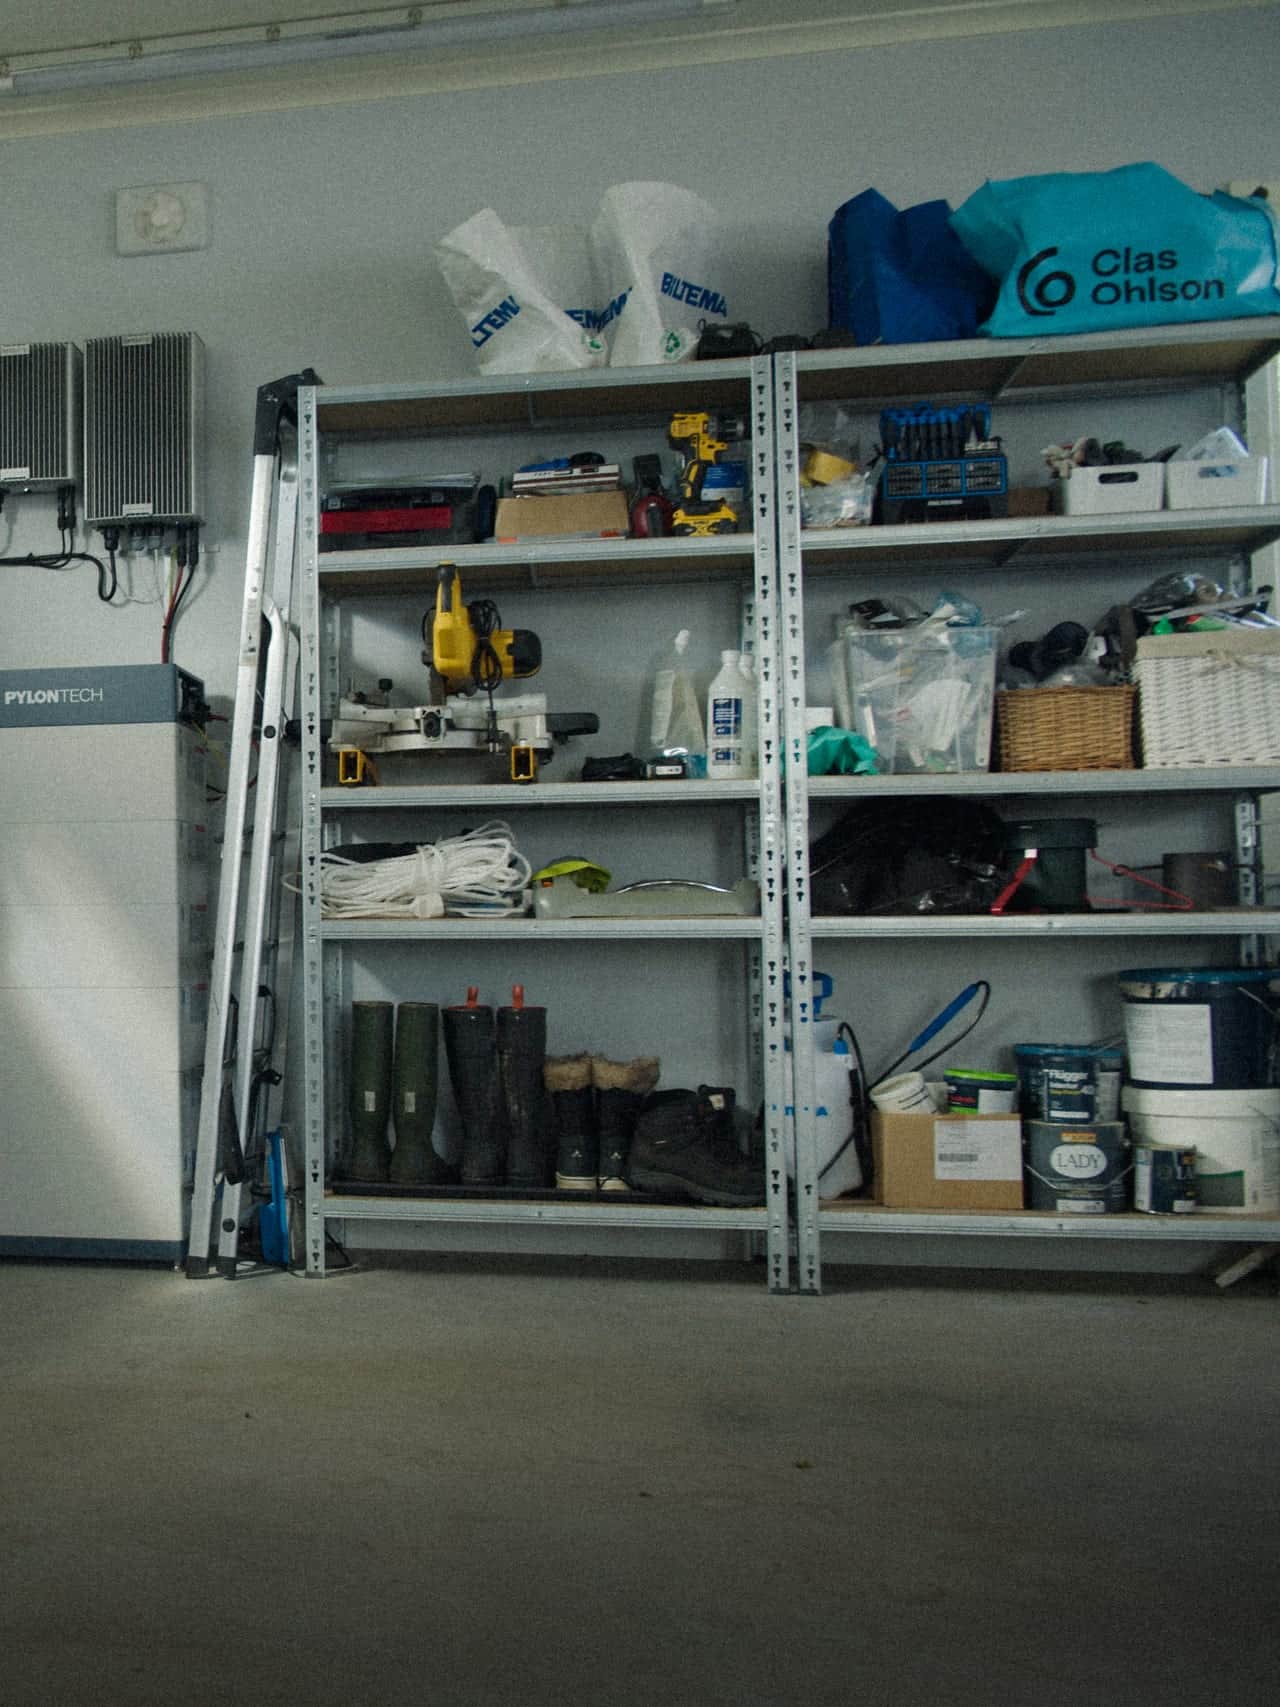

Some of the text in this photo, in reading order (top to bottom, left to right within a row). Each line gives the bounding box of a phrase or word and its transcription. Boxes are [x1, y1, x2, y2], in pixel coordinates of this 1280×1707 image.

[1091, 247, 1178, 277] Clas
[661, 271, 727, 318] BILTEMA
[1091, 277, 1225, 305] Ohlson
[4, 687, 104, 705] PYLONTECH
[1056, 1153, 1102, 1169] LADY
